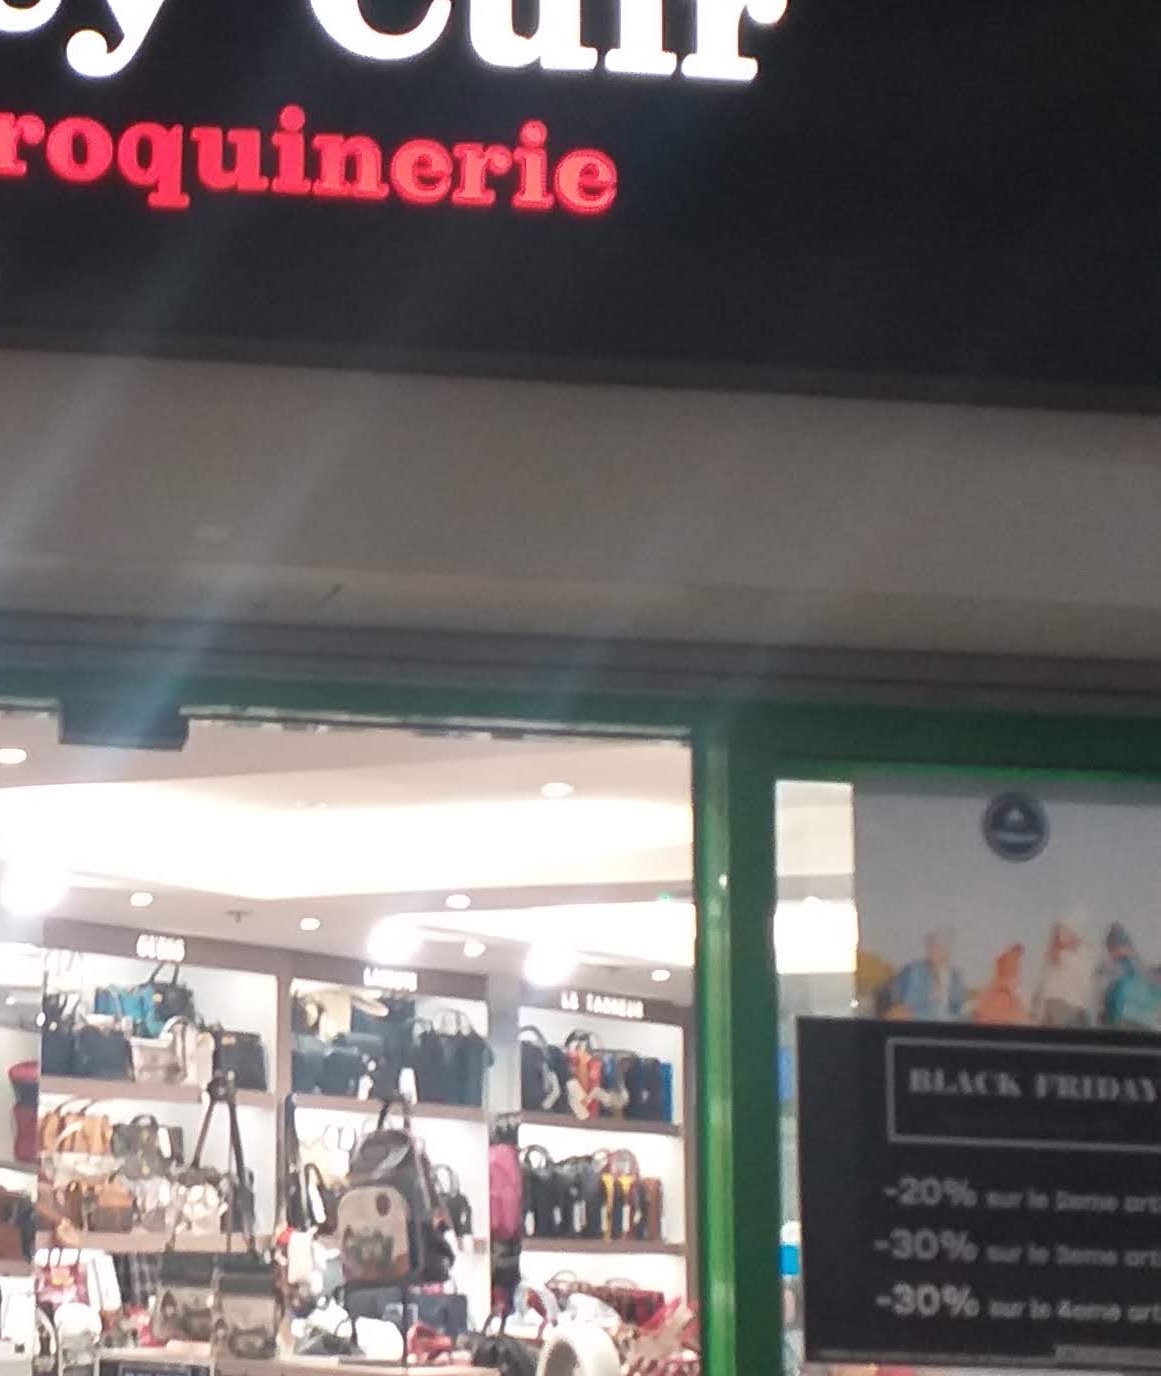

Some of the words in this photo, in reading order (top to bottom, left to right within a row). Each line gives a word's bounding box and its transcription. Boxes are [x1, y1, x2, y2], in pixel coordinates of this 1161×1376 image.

[909, 1067, 1022, 1097] BLACK
[1036, 1073, 1160, 1103] FRIDAY
[884, 1177, 978, 1207] -20%
[873, 1227, 979, 1262] -30%
[876, 1282, 980, 1317] -30%
